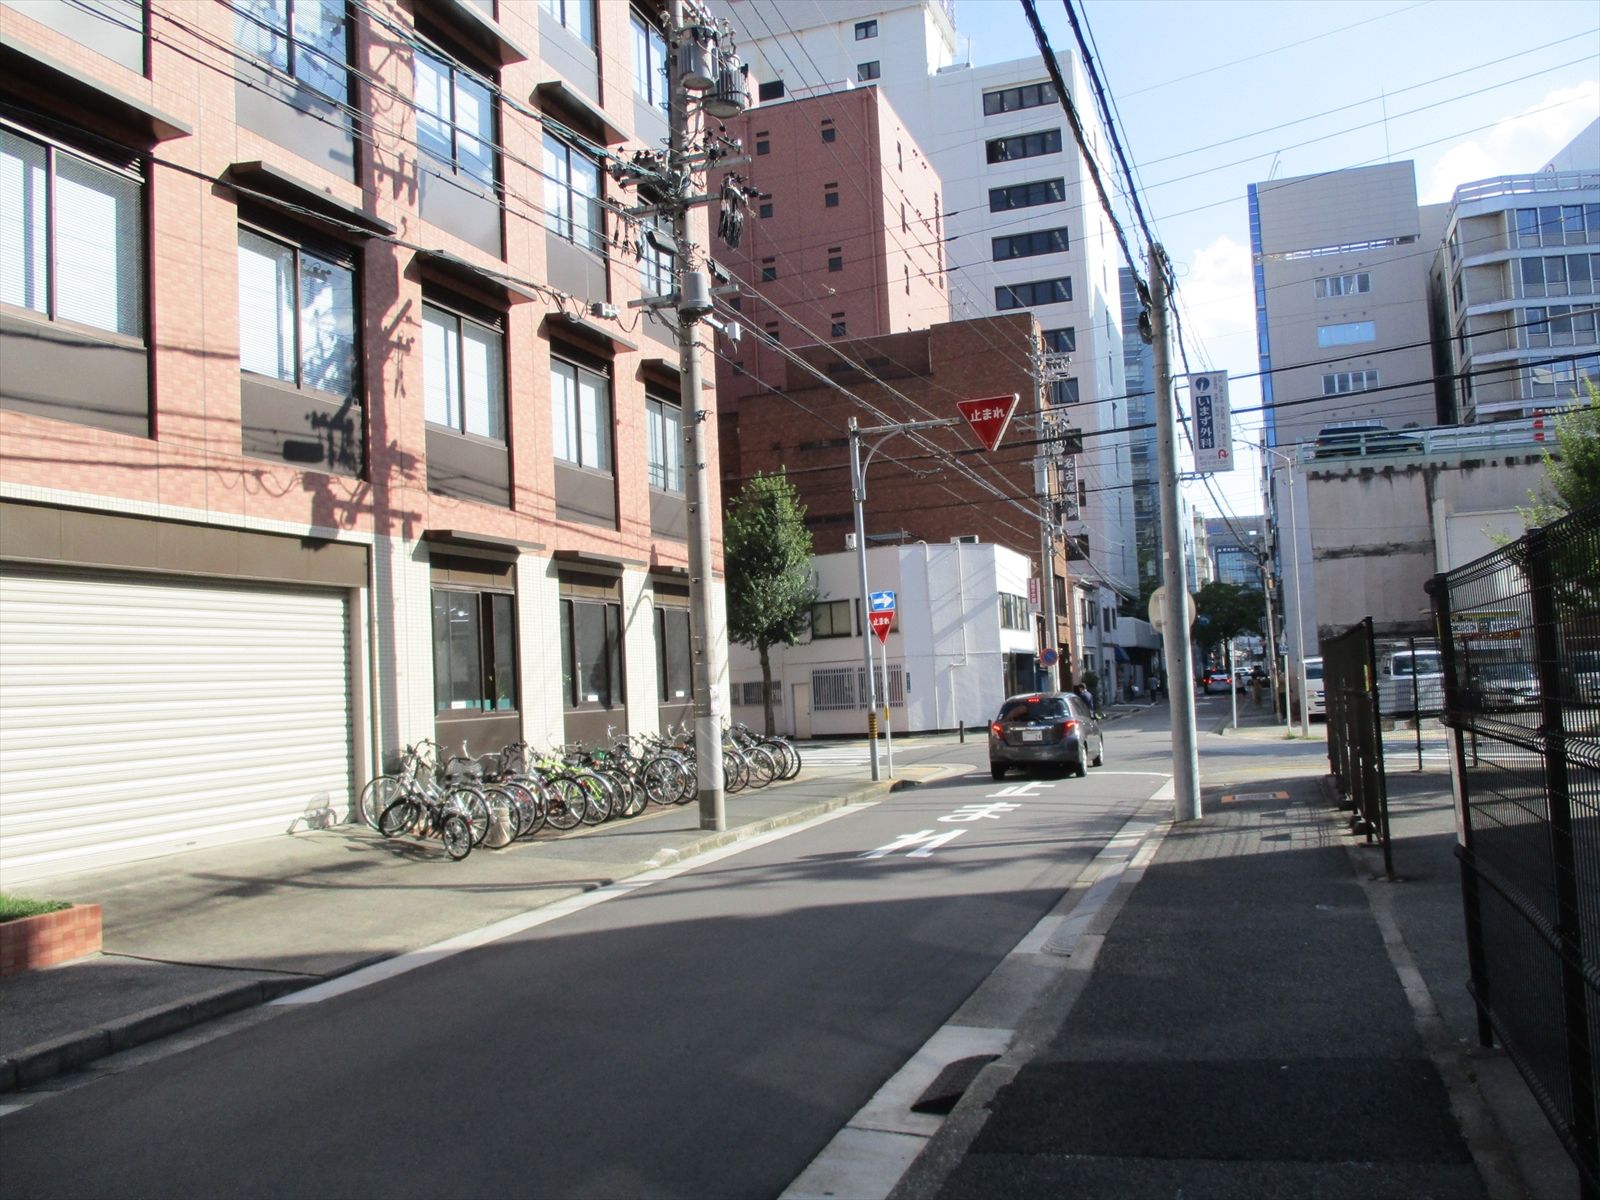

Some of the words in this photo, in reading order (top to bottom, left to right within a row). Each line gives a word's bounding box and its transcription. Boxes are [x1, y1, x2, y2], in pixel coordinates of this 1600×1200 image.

[970, 406, 1005, 422] 止まれ
[1198, 397, 1213, 449] いまず外科
[873, 616, 890, 626] 止まれ
[856, 781, 1056, 859] 止まれ
